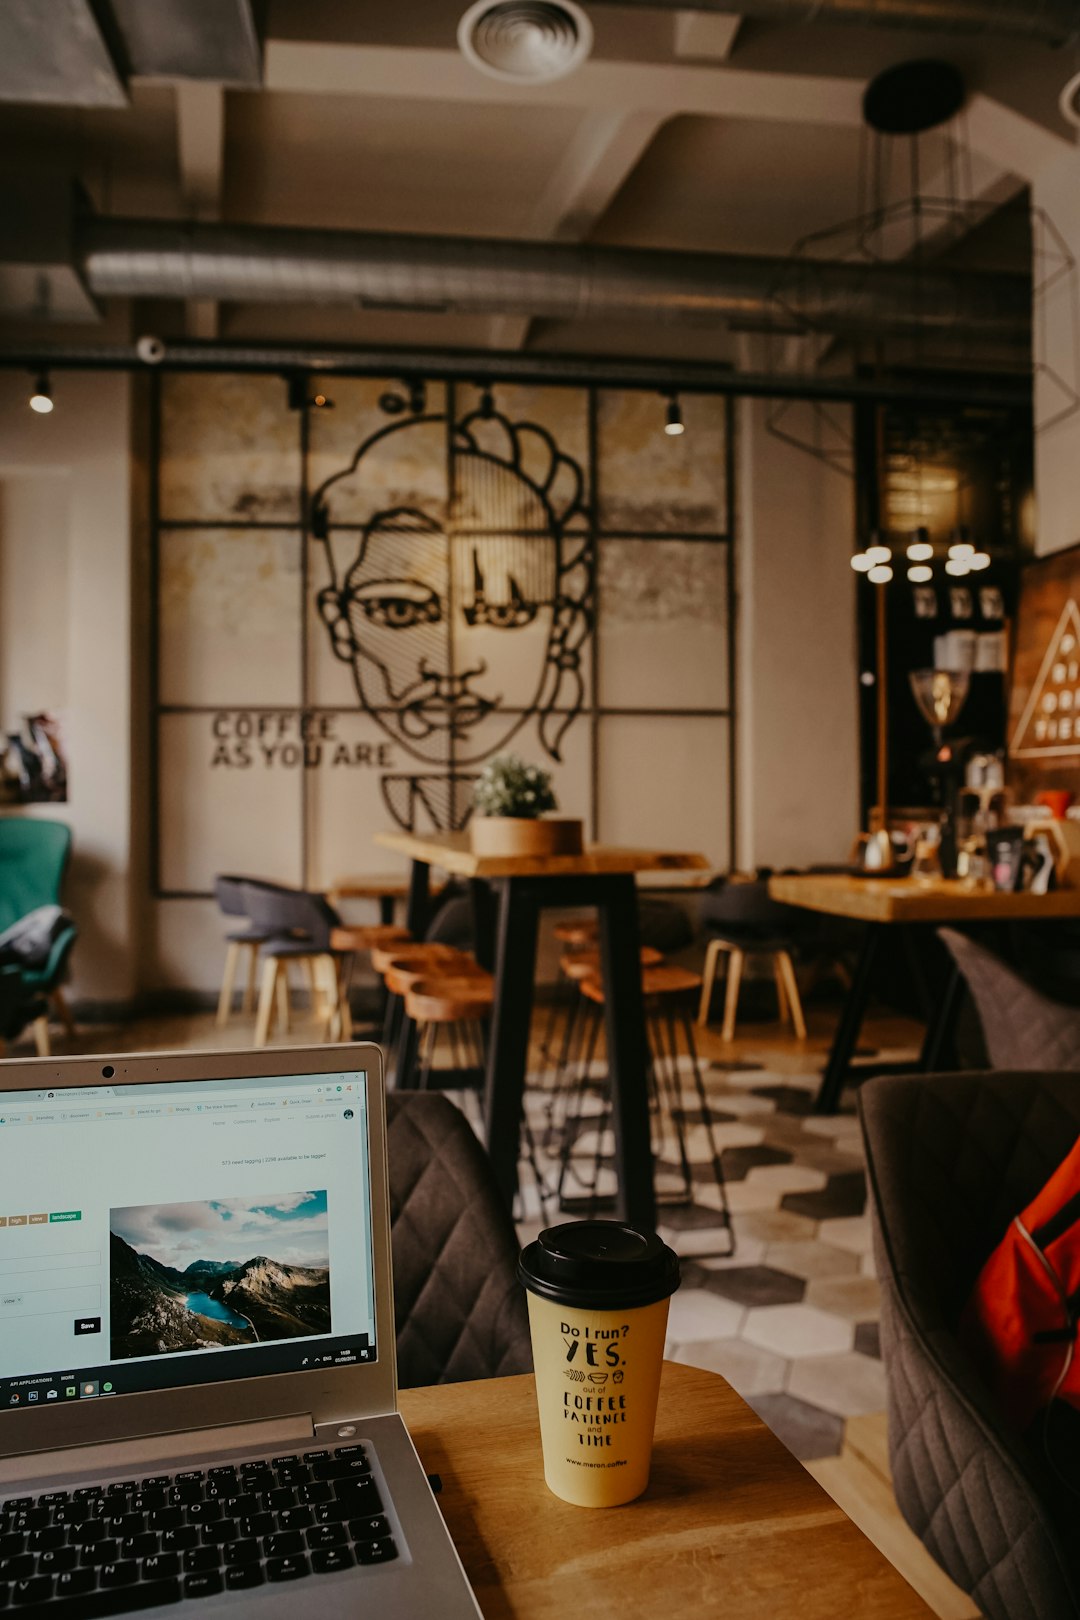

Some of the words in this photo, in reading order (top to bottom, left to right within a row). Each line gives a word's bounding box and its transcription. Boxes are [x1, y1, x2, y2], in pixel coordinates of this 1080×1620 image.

[212, 711, 337, 739] COFFEE
[211, 742, 253, 767] AS
[261, 743, 322, 768] YOU
[332, 743, 394, 768] ARE
[80, 1322, 95, 1330] Save
[560, 1321, 581, 1337] Do
[584, 1326, 590, 1339] I
[594, 1325, 630, 1340] run?
[562, 1336, 627, 1367] YES.
[582, 1386, 596, 1394] out
[597, 1386, 607, 1394] of
[563, 1391, 627, 1412] COFFEE
[563, 1409, 627, 1425] PATIENCE
[577, 1433, 613, 1448] TIME
[565, 1457, 628, 1469] www.meron.coffee
[113, 1516, 123, 1525] U
[74, 1523, 84, 1532] Y
[166, 1530, 175, 1539] K
[126, 1537, 134, 1546] J
[85, 1544, 95, 1553] H
[146, 1557, 158, 1567] M
[104, 1565, 115, 1574] N
